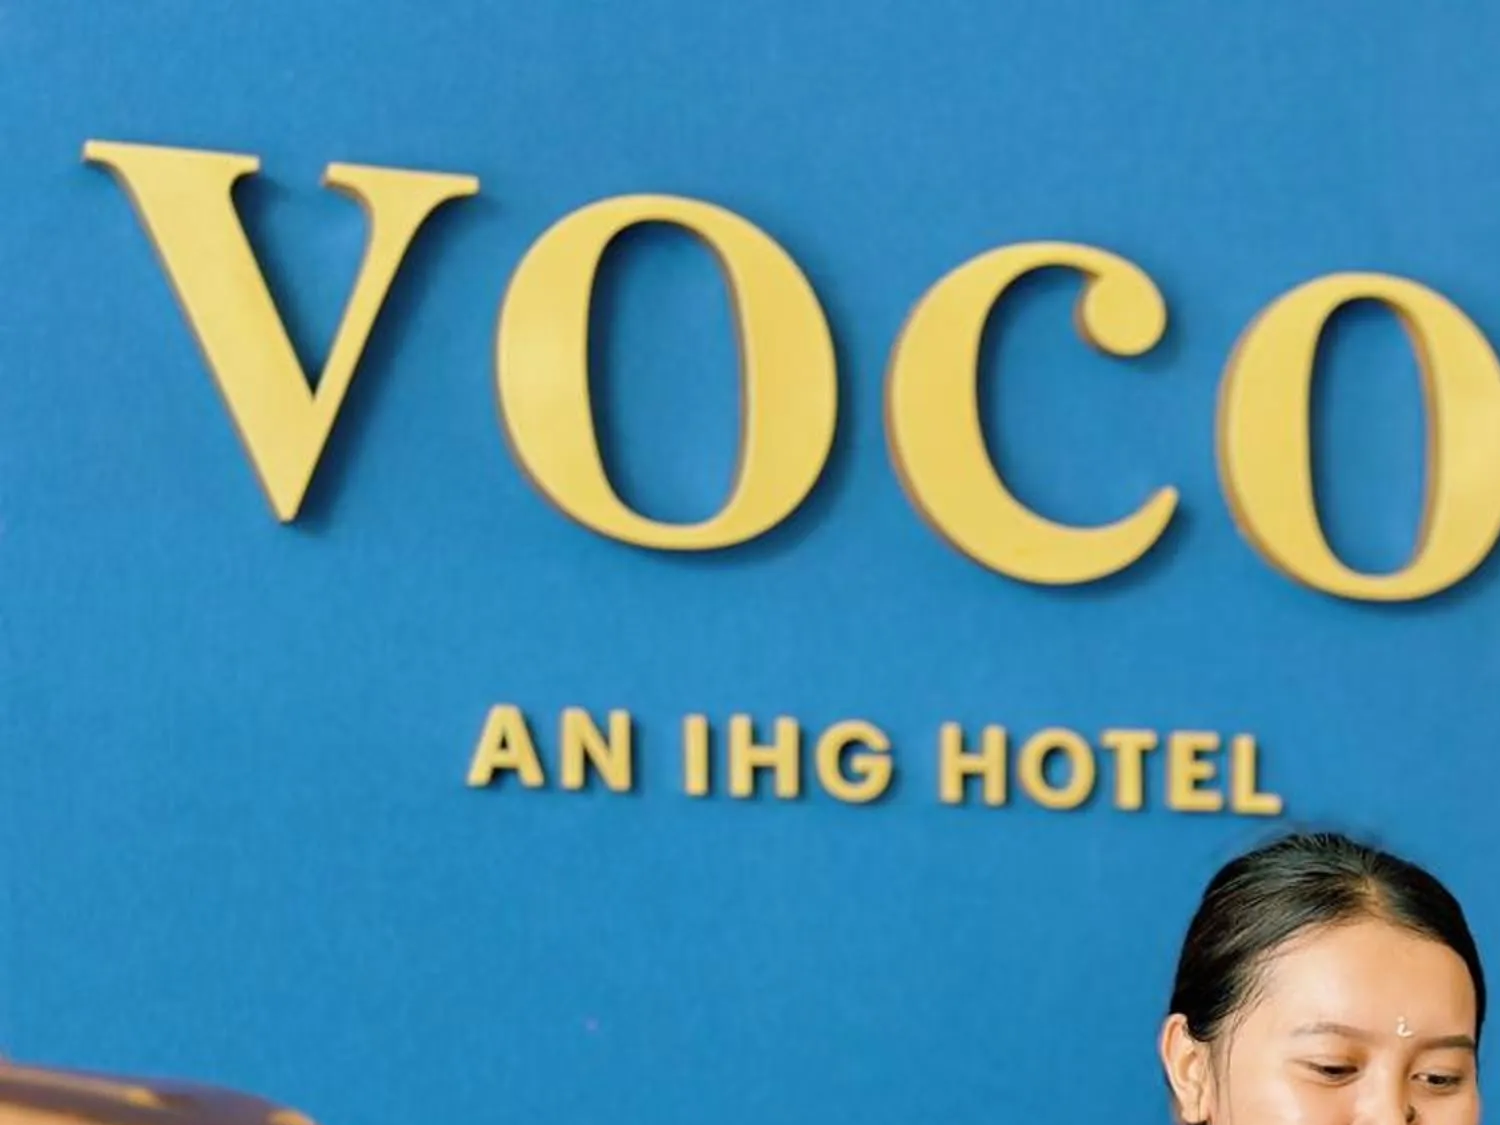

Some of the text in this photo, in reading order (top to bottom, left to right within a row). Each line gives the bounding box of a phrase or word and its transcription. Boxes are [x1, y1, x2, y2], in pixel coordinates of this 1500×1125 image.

[467, 704, 1283, 816] AN IHG HOTEL
